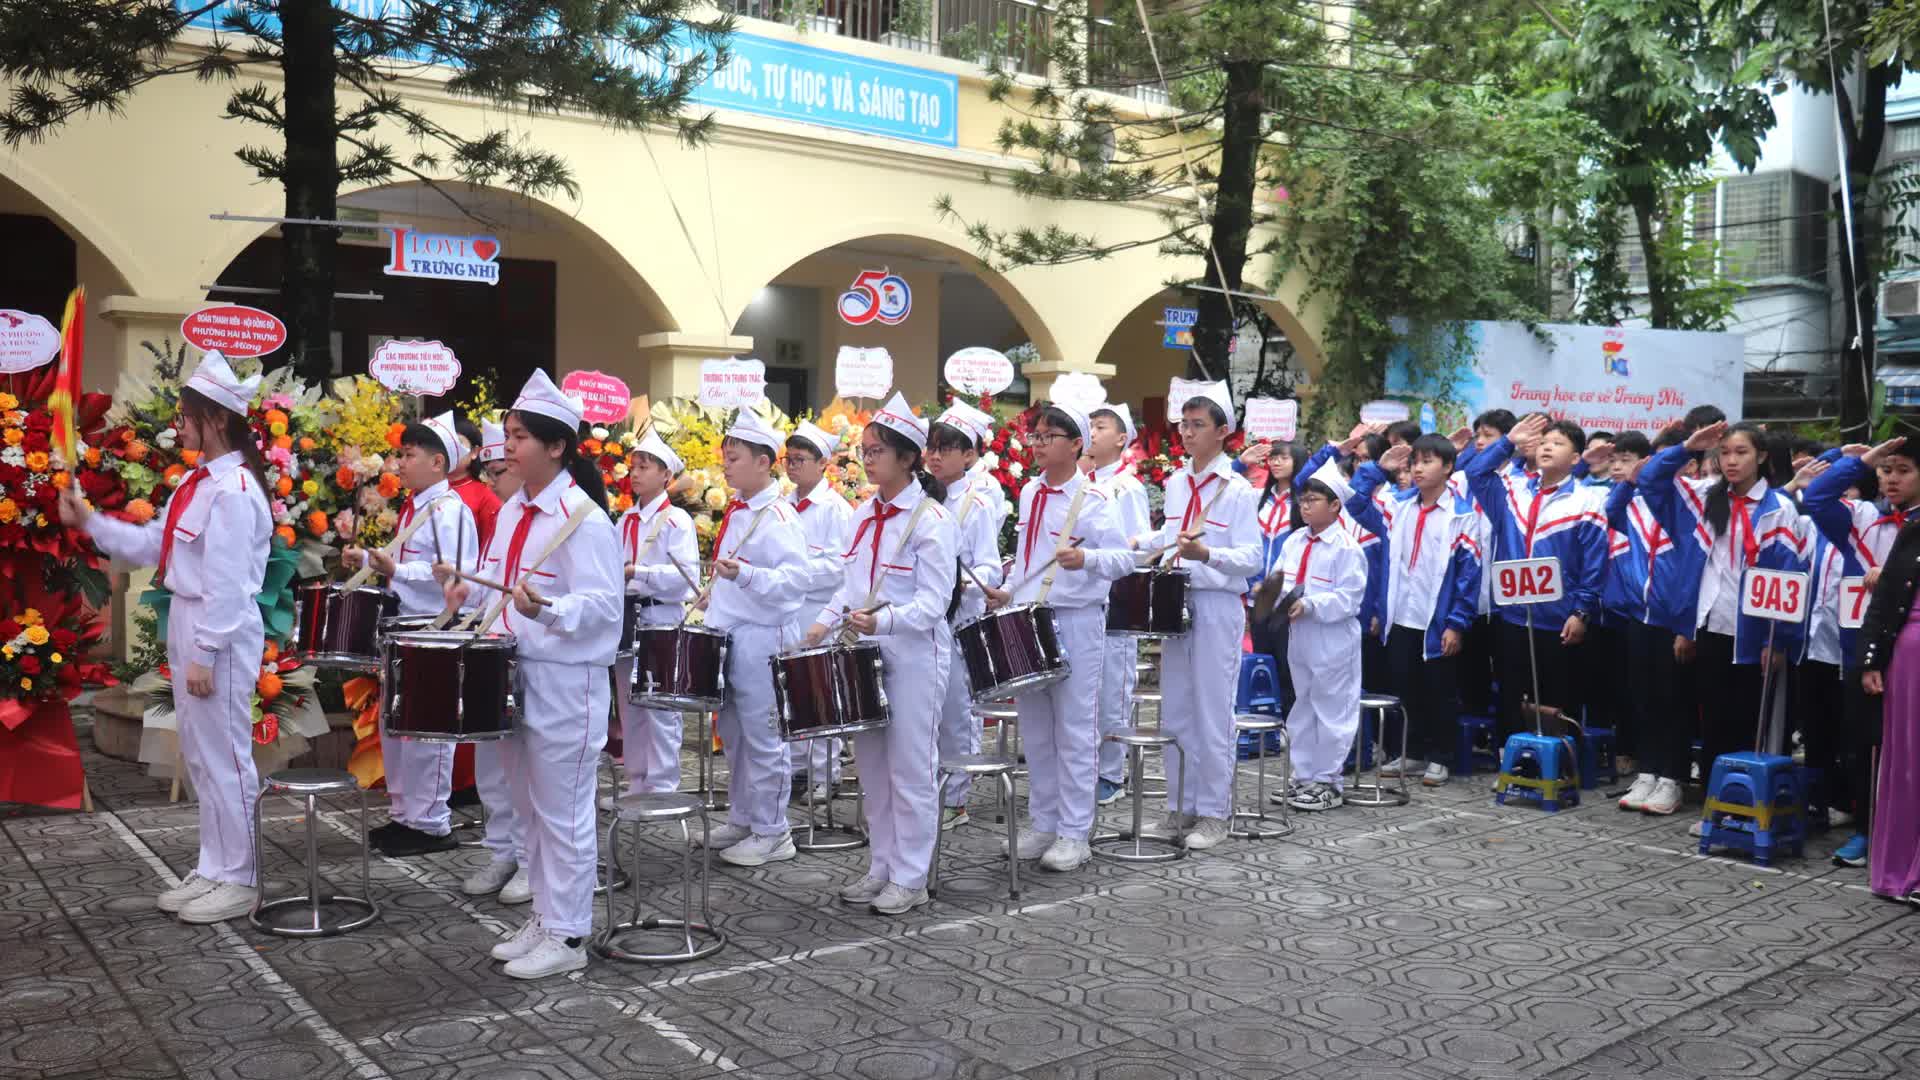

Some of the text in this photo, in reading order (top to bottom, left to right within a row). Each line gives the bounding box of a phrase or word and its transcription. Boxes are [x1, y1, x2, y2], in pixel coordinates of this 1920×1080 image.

[763, 63, 787, 108] TỰ
[791, 69, 826, 112] HỌC
[832, 72, 855, 112] VÀ
[860, 77, 905, 122] SÁNG
[909, 90, 940, 133] TẠO
[391, 228, 471, 272] I LOVE
[411, 259, 496, 280] TRƯNG NHỊ
[838, 270, 911, 325] 50
[1166, 310, 1197, 324] TRƯN
[192, 326, 278, 342] PHƯỜNG HAI BÀ TRƯNG
[1510, 381, 1551, 407] Trung
[1553, 384, 1575, 404] học
[1579, 390, 1594, 403] cơ
[1615, 385, 1654, 411] Trưng
[1658, 387, 1685, 408] Nhị
[1500, 565, 1554, 597] 9A2
[1751, 575, 1800, 614] 9A3
